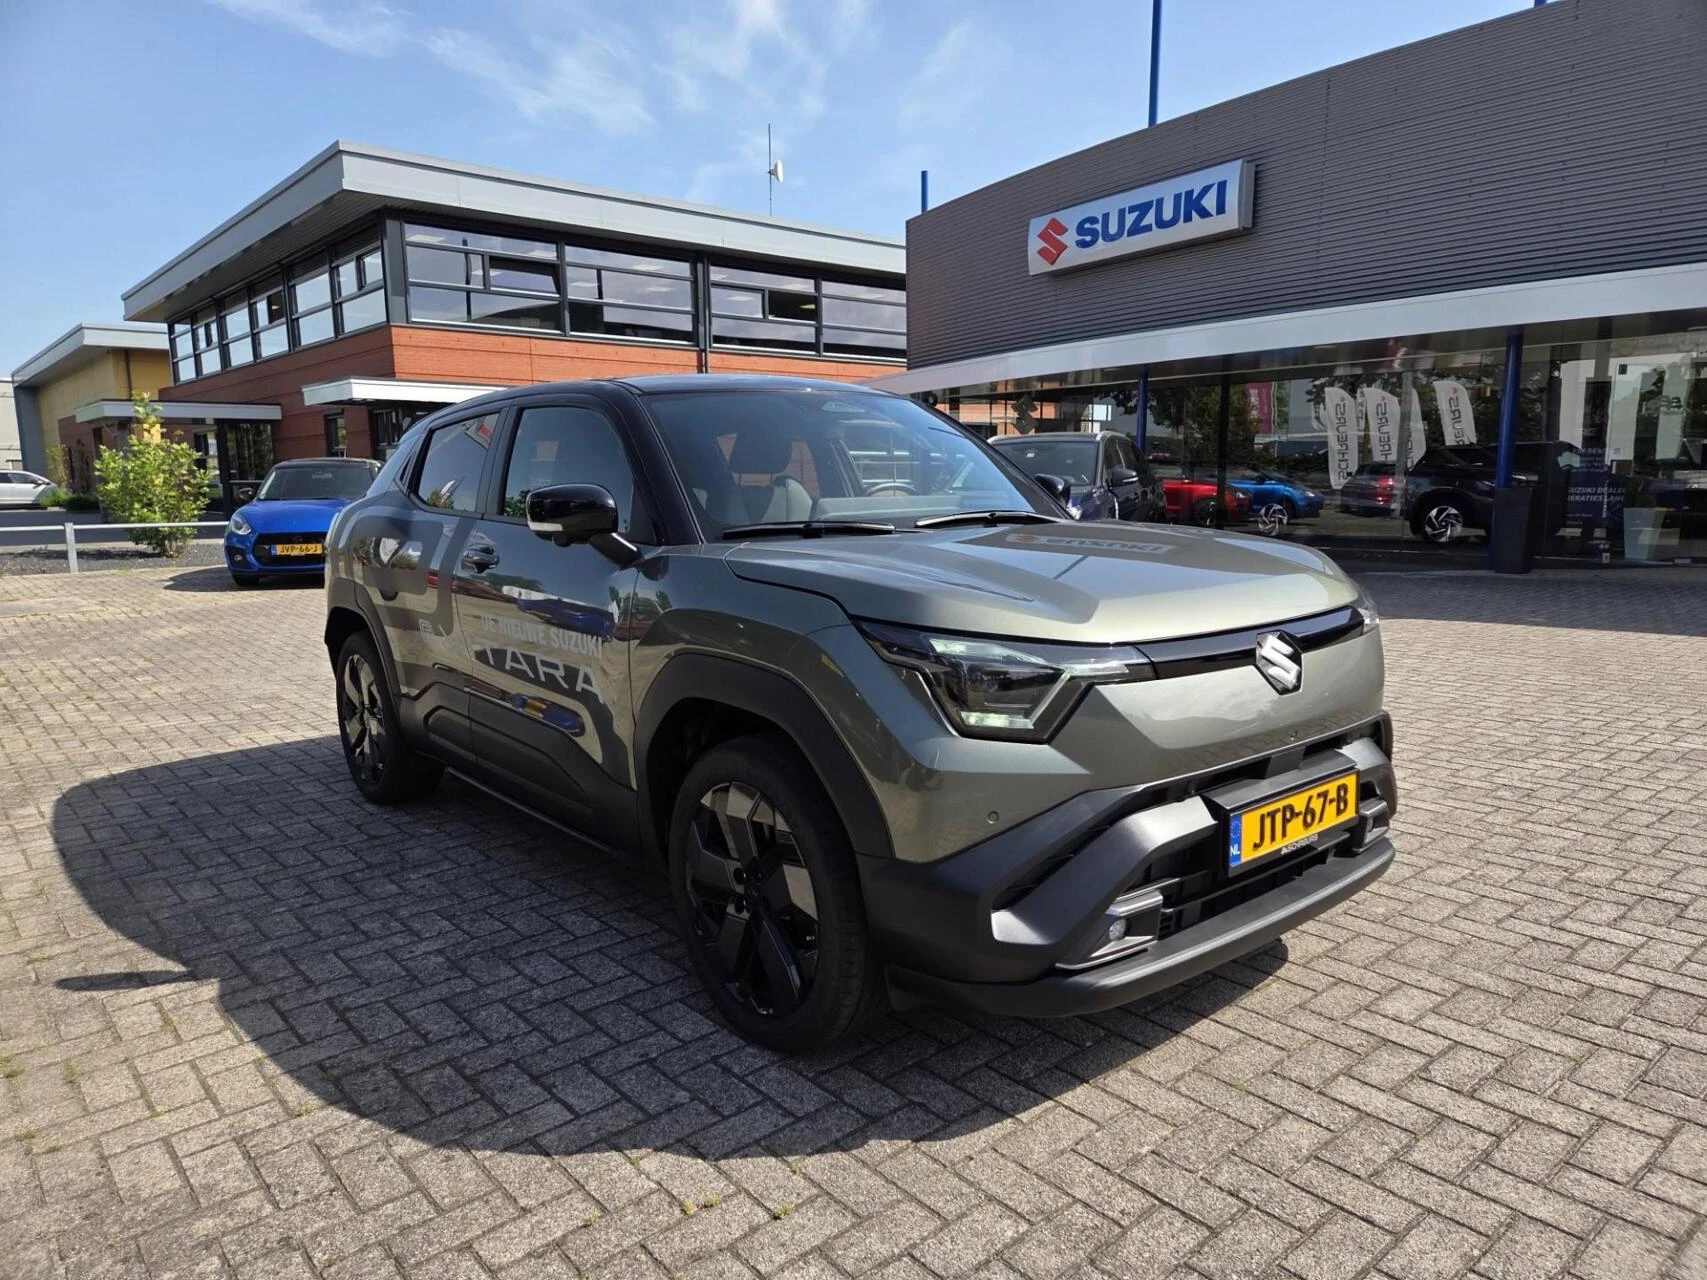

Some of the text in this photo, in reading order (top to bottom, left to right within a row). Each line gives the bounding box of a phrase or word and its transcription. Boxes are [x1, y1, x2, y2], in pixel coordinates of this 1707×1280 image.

[1074, 179, 1227, 249] SUZUKI
[499, 616, 546, 645] NIEUWE
[550, 627, 602, 658] SUZUKI
[1252, 783, 1349, 851] JTP-67-B
[1230, 843, 1240, 857] NL
